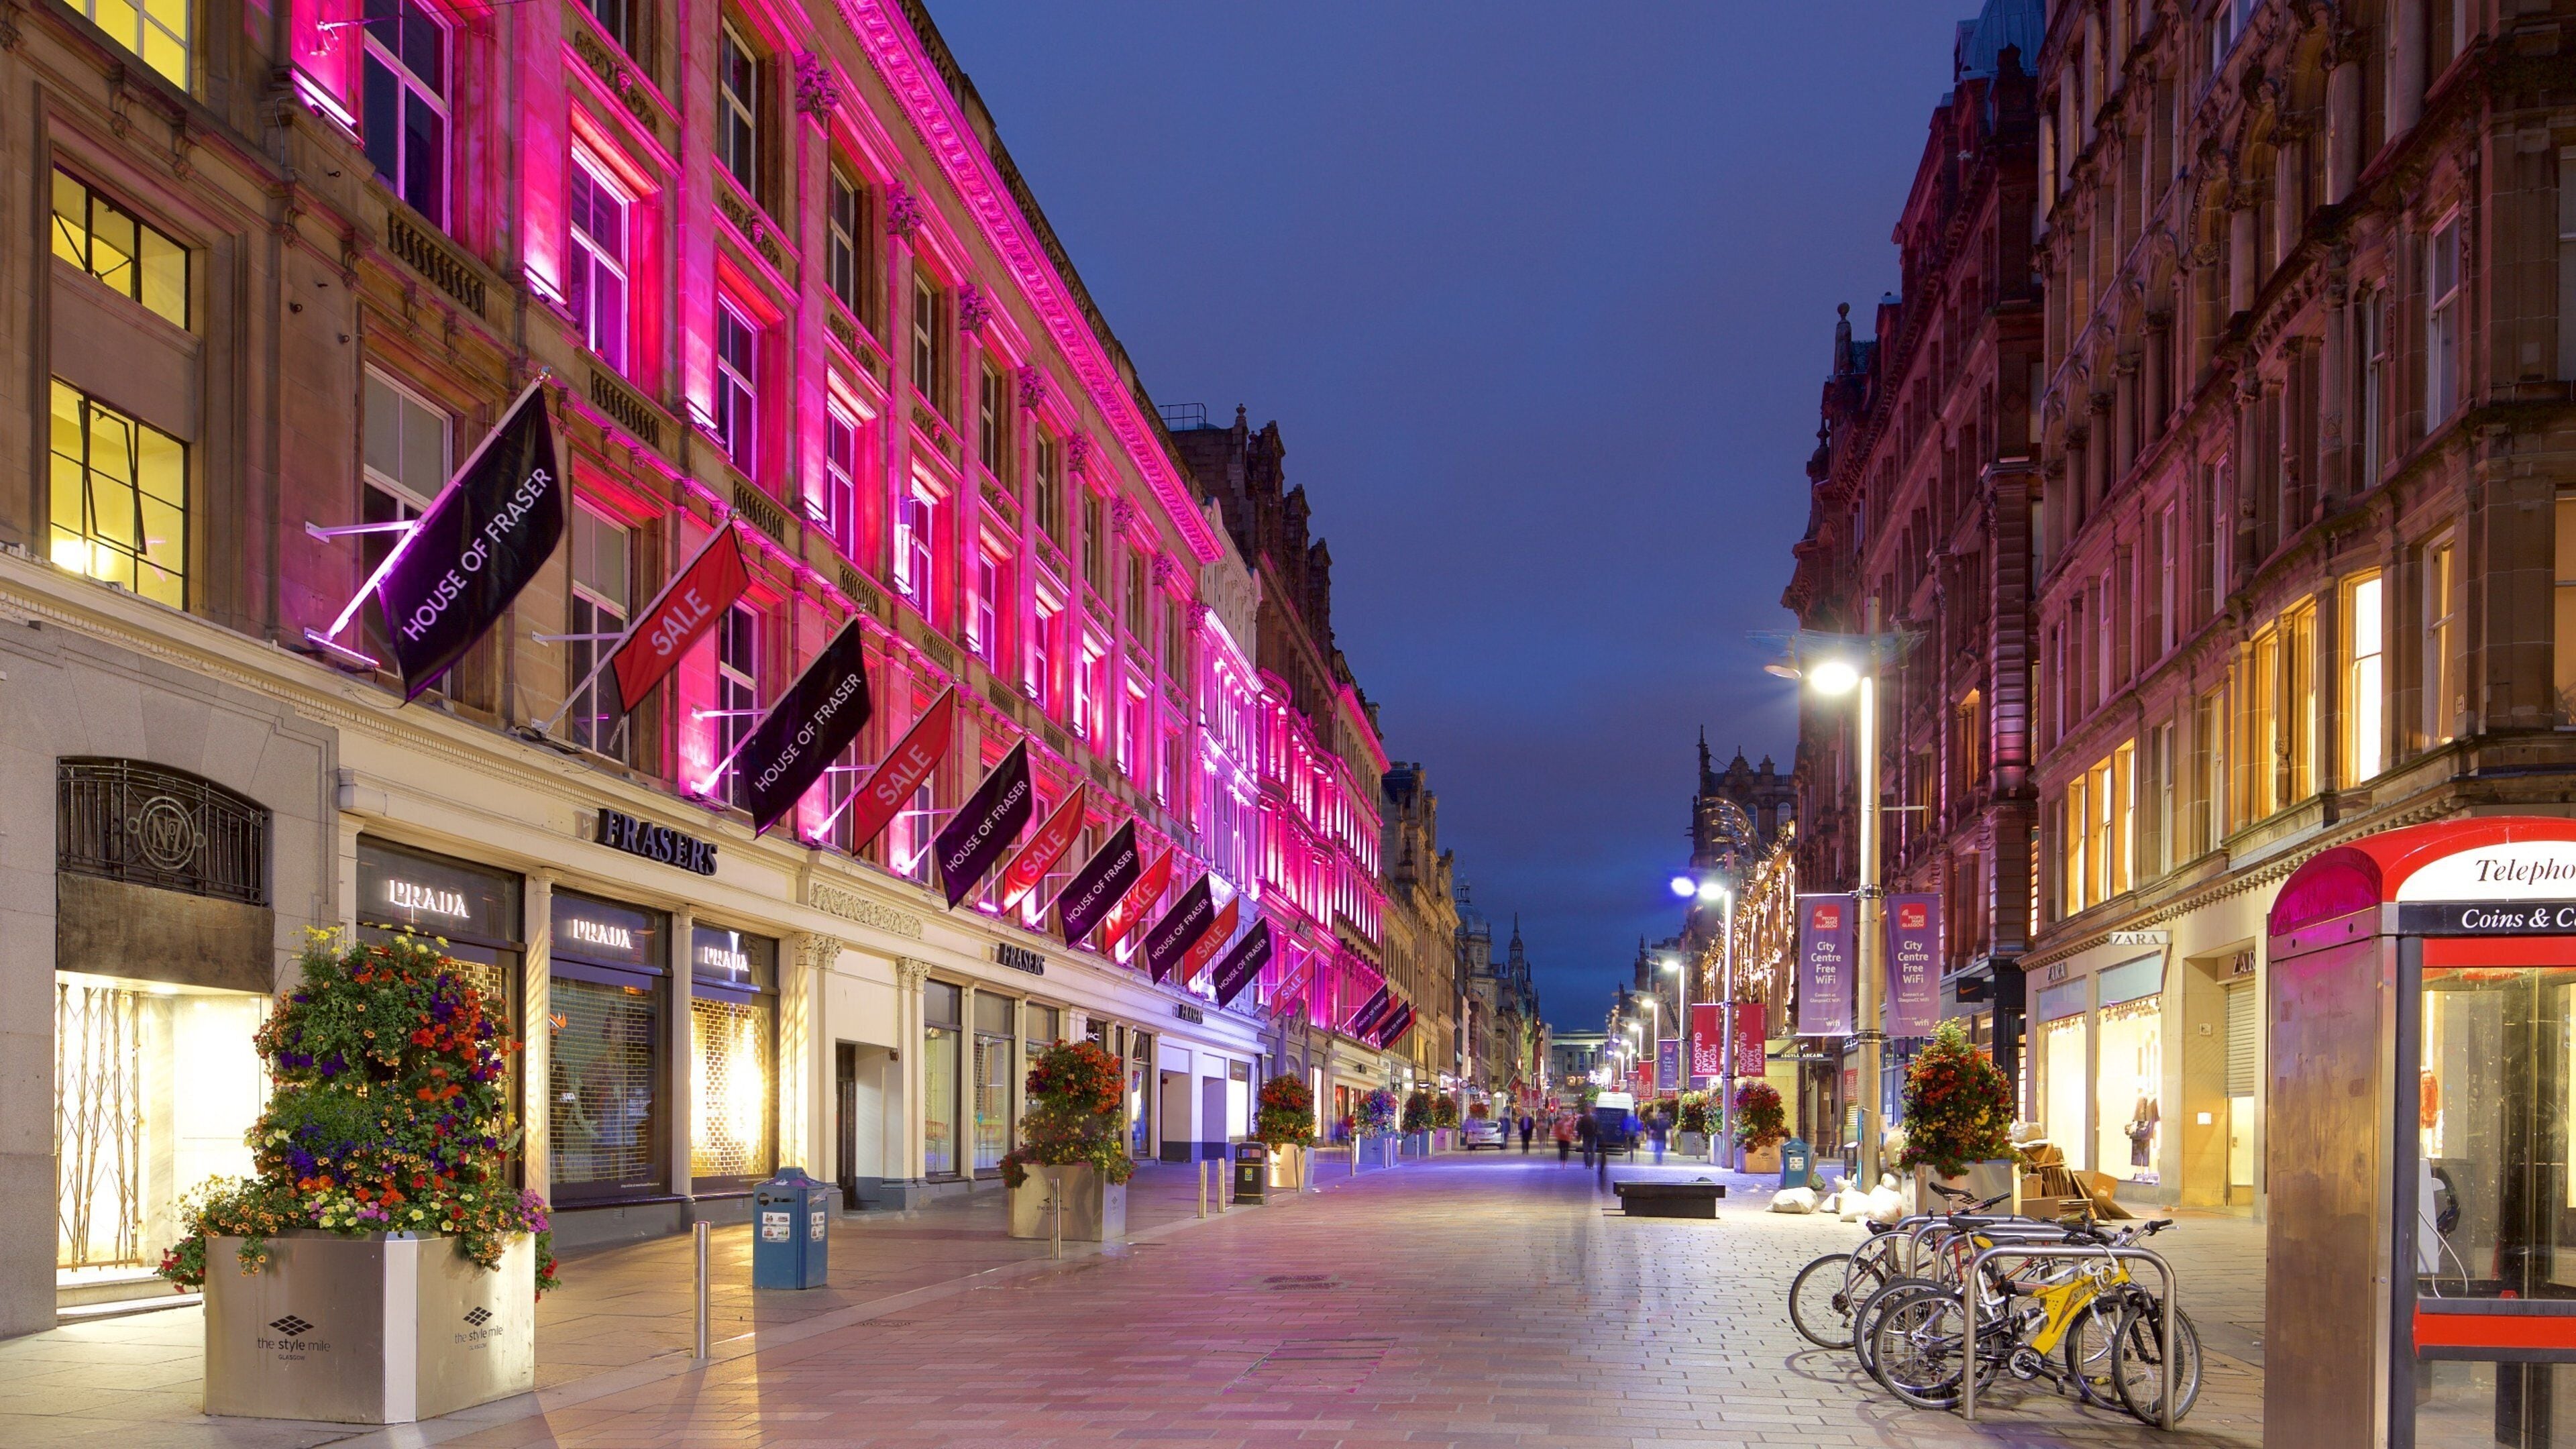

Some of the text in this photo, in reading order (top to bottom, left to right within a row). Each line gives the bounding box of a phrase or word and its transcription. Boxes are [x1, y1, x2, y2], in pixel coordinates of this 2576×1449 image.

[402, 468, 552, 641] HOUSE OF FRASER
[651, 588, 711, 656] SALE
[755, 674, 861, 792] HOUSE OF FRASER
[877, 745, 932, 806] SALE
[946, 780, 1028, 873] HOUSE OF FRASER
[600, 809, 718, 875] FRASERS
[1022, 828, 1066, 877] SALE
[388, 879, 470, 919] PRADA
[1067, 850, 1134, 924] HOUSE OF FRASER
[1122, 883, 1157, 922] SALE
[1152, 898, 1208, 960] HOUSE OF FRASER
[2462, 909, 2524, 928] Coins
[2528, 908, 2551, 928] &
[572, 918, 633, 949] PRADA
[1197, 925, 1227, 959] SALE
[1817, 942, 1835, 952] City
[1904, 941, 1923, 951] City
[2112, 933, 2159, 945] ZARA
[703, 946, 750, 972] PRADA
[1002, 943, 1046, 975] FRASERS
[1219, 938, 1267, 990] HOUSE OF FRASER
[1811, 953, 1841, 962] Centre
[1816, 964, 1836, 973] Free
[1898, 952, 1929, 961] Centre
[1903, 963, 1924, 972] Free
[1815, 975, 1836, 984] WiFi
[1902, 974, 1924, 983] WiFi
[2046, 961, 2066, 983] ZARA
[1281, 975, 1305, 1000] SALE
[1357, 1016, 1370, 1028] HOUSE
[1374, 997, 1387, 1011] FRASER
[1826, 1019, 1840, 1027] wifi
[258, 1338, 331, 1352] the style mile
[455, 1326, 503, 1344] the style mile
